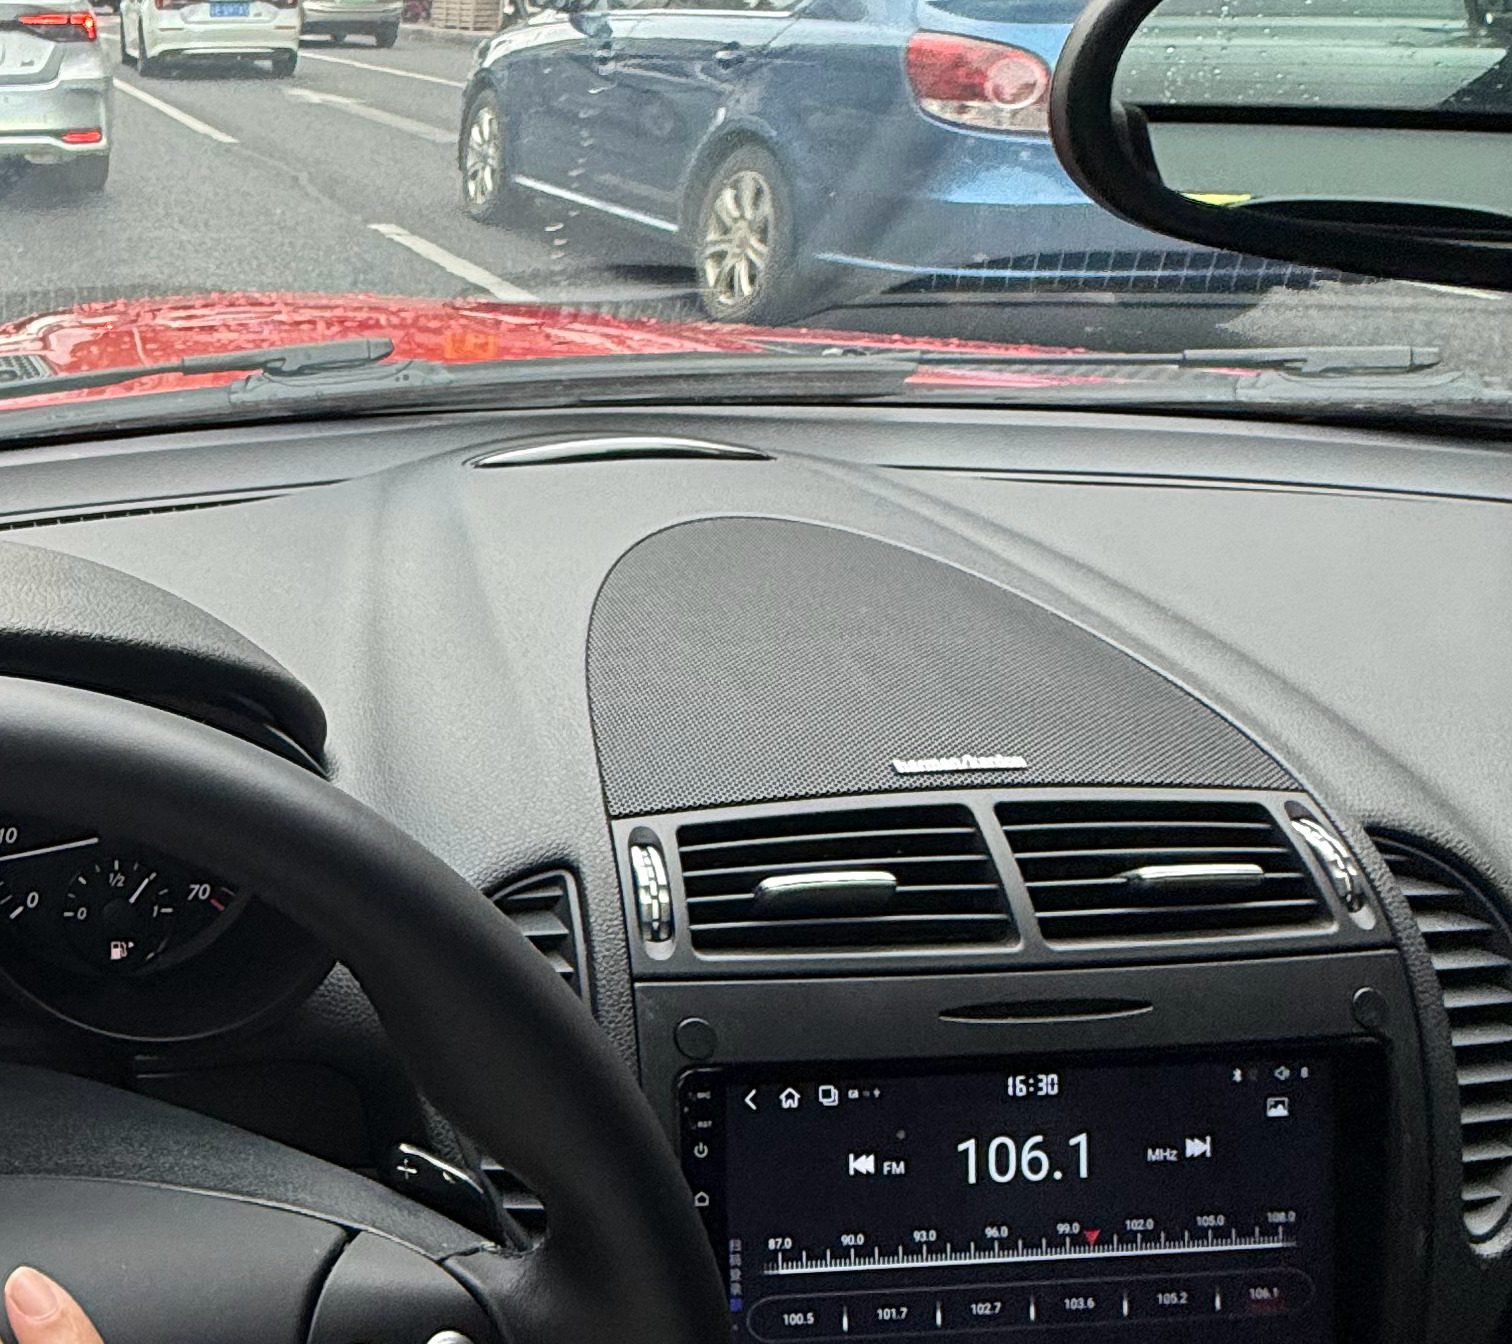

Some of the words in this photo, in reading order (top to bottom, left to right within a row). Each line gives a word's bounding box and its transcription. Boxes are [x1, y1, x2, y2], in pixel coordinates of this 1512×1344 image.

[26, 891, 39, 909] 0
[187, 883, 211, 901] 70
[76, 907, 87, 920] 0
[152, 905, 159, 918] 1
[1007, 1073, 1059, 1097] 16:30
[957, 1132, 1088, 1185] 106.1
[1146, 1147, 1178, 1162] MHz
[882, 1160, 906, 1176] FM
[767, 1237, 793, 1251] 87.0
[840, 1233, 865, 1247] 90.0
[912, 1229, 937, 1243] 93.0
[984, 1225, 1009, 1239] 96.0
[1056, 1221, 1081, 1235] 99.0
[1124, 1218, 1155, 1232] 102.0
[1196, 1214, 1225, 1228] 105.0
[1266, 1210, 1297, 1224] 108.0
[782, 1312, 815, 1326] 100.5
[876, 1306, 909, 1321] 101.7
[970, 1301, 1002, 1316] 102.7
[1064, 1297, 1096, 1311] 103.6
[1156, 1291, 1189, 1306] 105.2
[1249, 1287, 1280, 1300] 106.1
